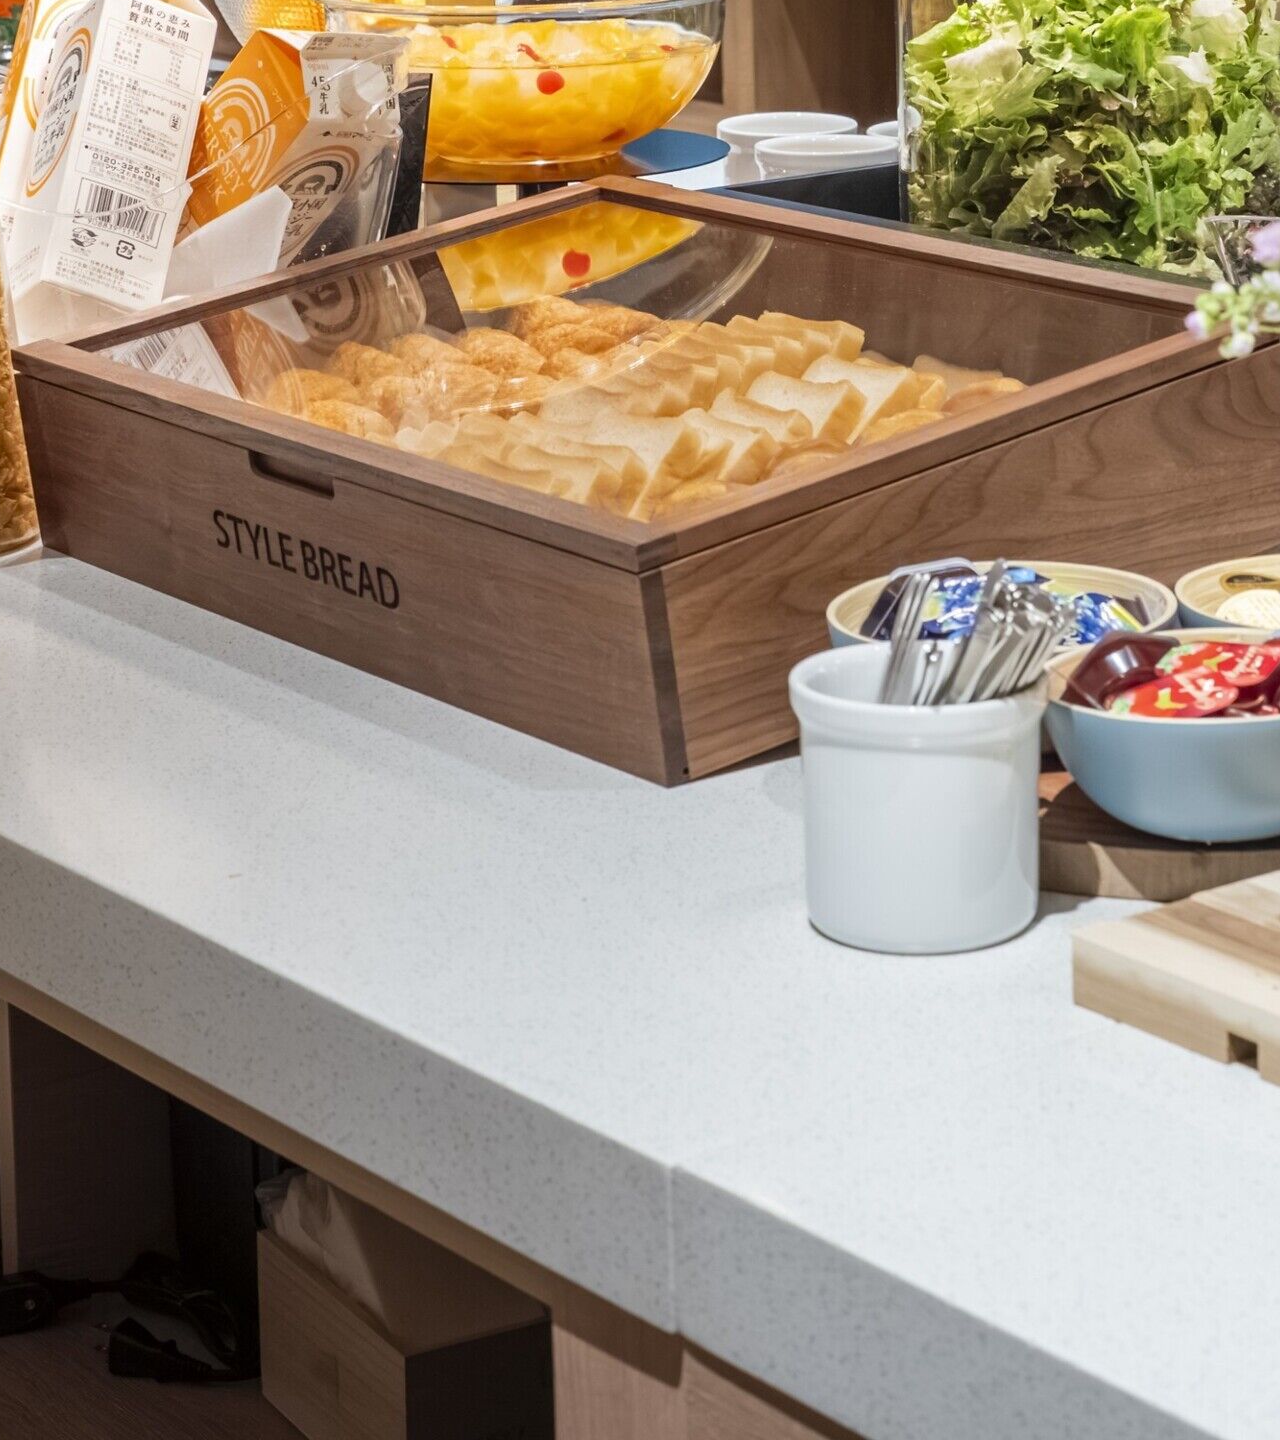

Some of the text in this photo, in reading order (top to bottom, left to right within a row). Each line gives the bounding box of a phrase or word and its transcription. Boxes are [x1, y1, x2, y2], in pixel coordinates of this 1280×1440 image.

[128, 11, 189, 42] 贅沢な時間
[130, 0, 191, 29] 阿蘇の恵み
[212, 509, 401, 610] STYLE BREAD
